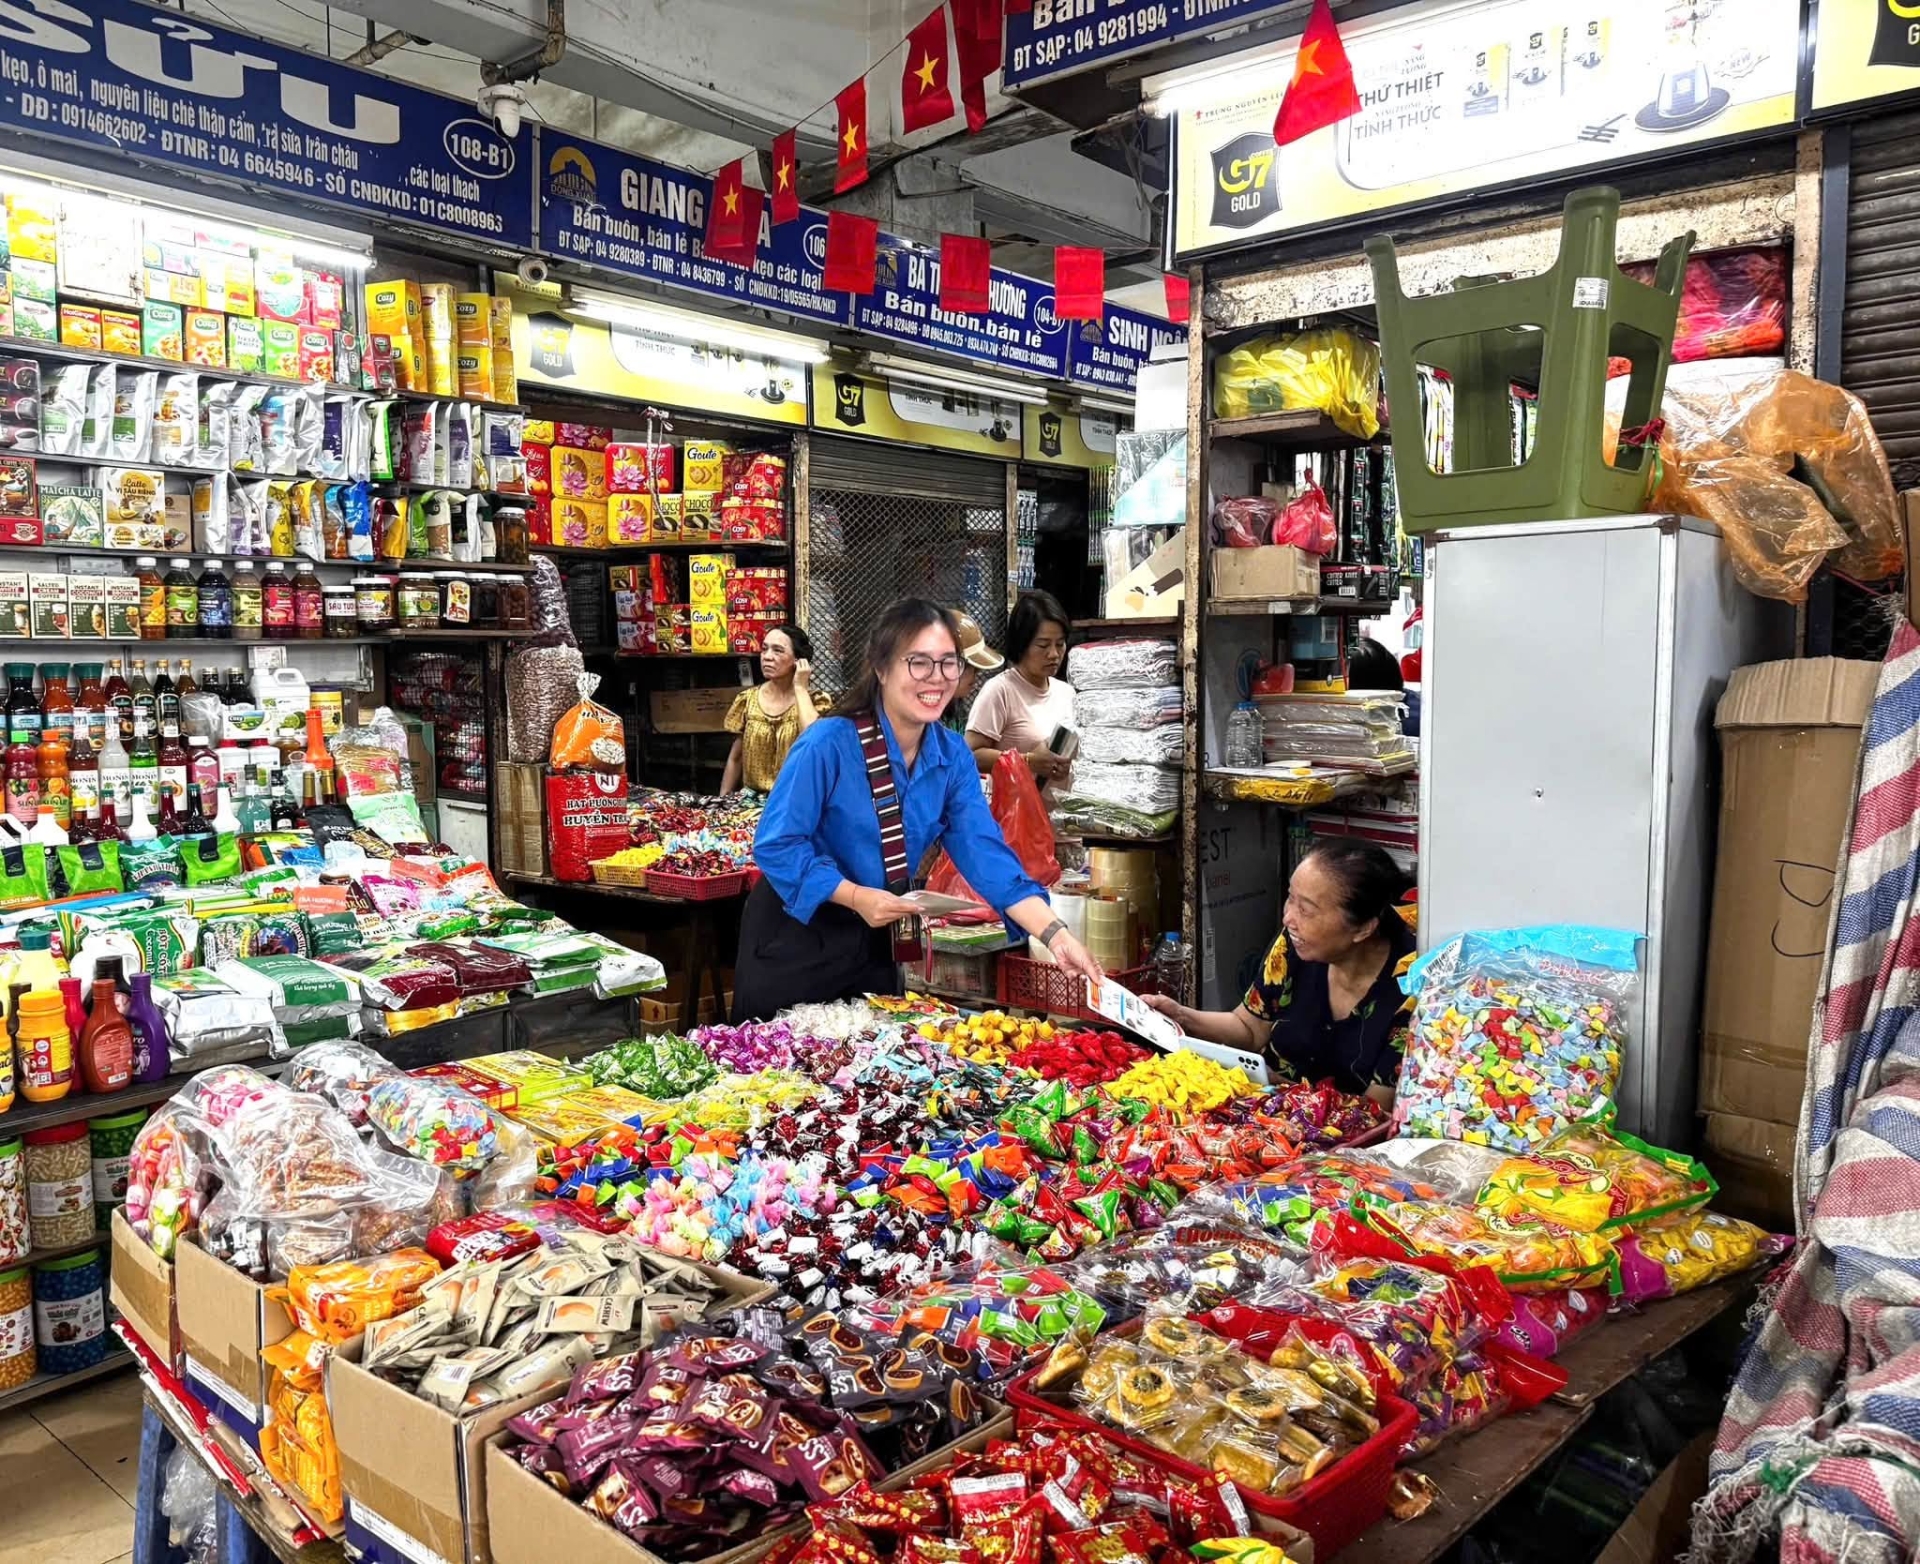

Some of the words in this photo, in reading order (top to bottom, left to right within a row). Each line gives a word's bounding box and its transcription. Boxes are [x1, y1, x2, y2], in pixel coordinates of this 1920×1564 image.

[1014, 45, 1031, 72] ĐT
[1074, 28, 1094, 53] 04
[1098, 8, 1168, 46] 9281994
[60, 104, 147, 146] 0914662602
[218, 145, 240, 169] 04
[244, 152, 314, 188] 6645946
[90, 78, 140, 116] nguyên
[143, 88, 169, 125] liệu
[172, 100, 196, 128] chè
[198, 104, 227, 140] thập
[305, 134, 329, 164] trân
[330, 141, 359, 171] châu
[431, 172, 450, 195] loại
[452, 179, 481, 204] thạch
[450, 133, 508, 169] 108-B1
[1219, 154, 1274, 194] G7
[620, 167, 704, 230] GIANG
[1231, 191, 1261, 213] GOLD
[595, 243, 607, 257] 04
[609, 245, 646, 268] 9280389
[681, 262, 692, 277] 04
[692, 264, 726, 288] 8436799
[647, 228, 672, 250] bán
[776, 262, 798, 286] các
[801, 267, 823, 295] loại
[377, 292, 395, 303] Cozy
[1108, 316, 1149, 352] SINH
[543, 352, 563, 367] GOLD
[839, 383, 862, 408] G7
[1042, 421, 1060, 440] G7
[40, 485, 76, 497] MATCHA
[600, 1297, 614, 1326] CASHEW
